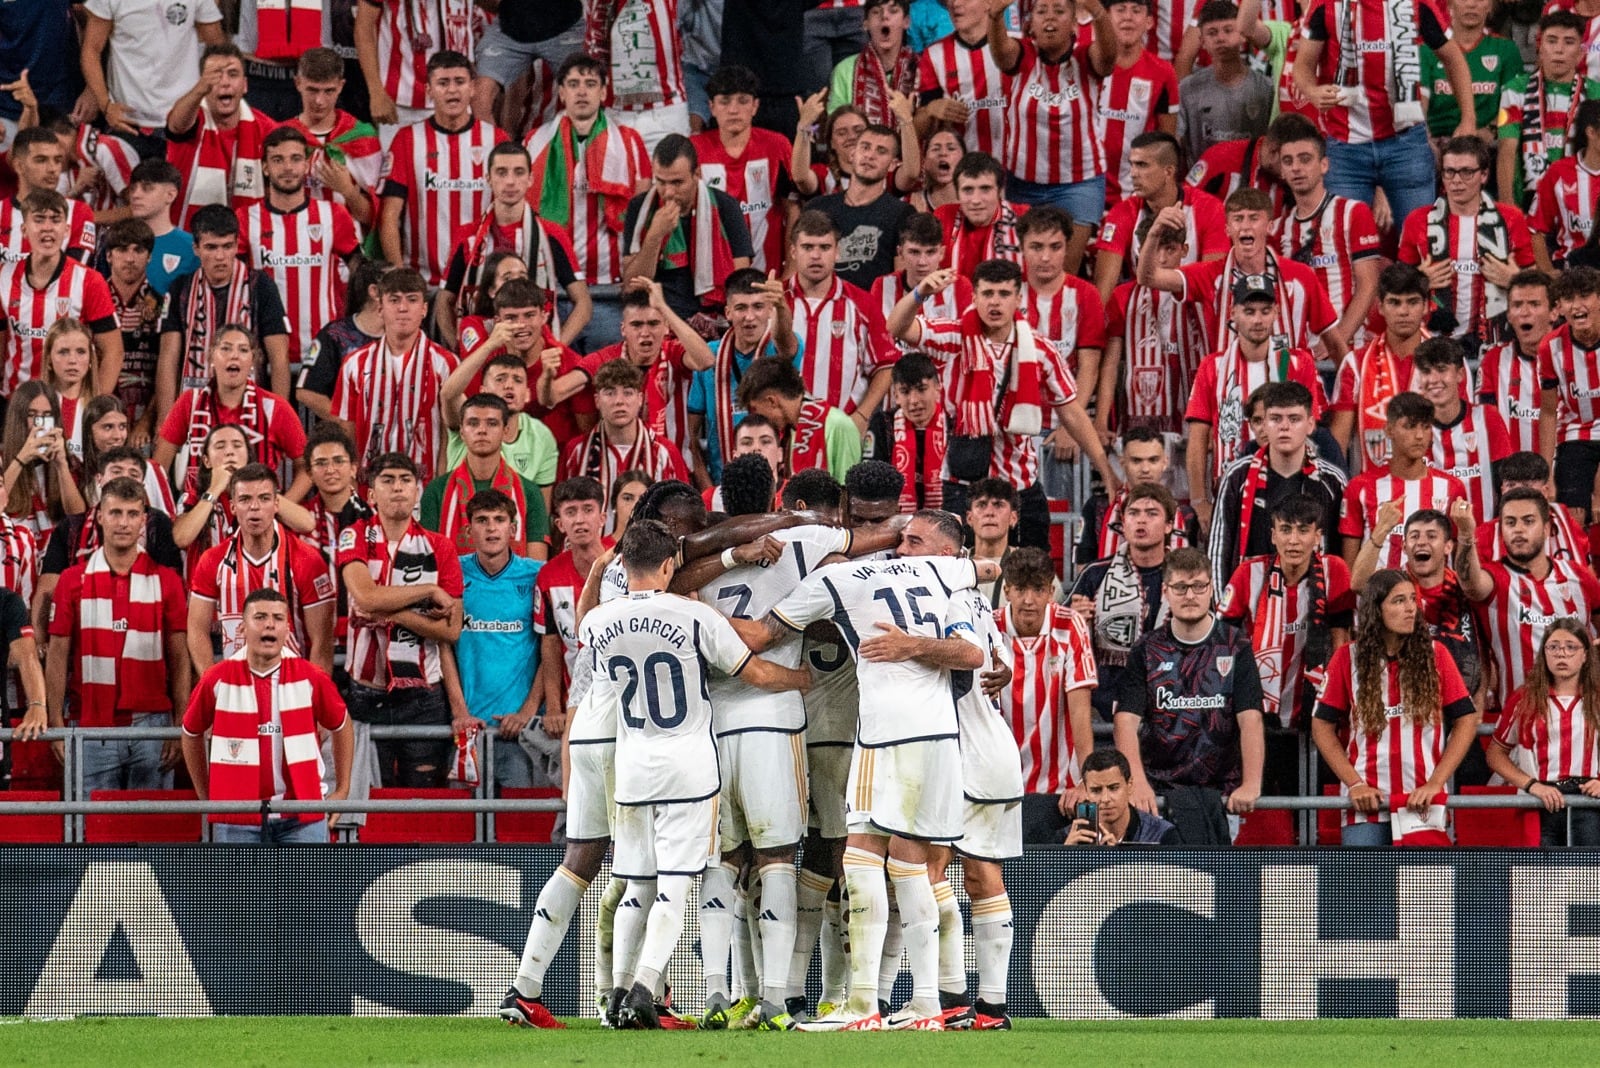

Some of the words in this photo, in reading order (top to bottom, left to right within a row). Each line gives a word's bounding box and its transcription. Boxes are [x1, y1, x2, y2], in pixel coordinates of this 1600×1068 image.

[261, 247, 322, 265] Kutxabank
[463, 615, 522, 631] Kutxabank
[595, 619, 625, 654] FRAN
[629, 617, 686, 649] GARCÍA
[608, 651, 687, 729] 20
[1157, 687, 1225, 708] Kutxabank
